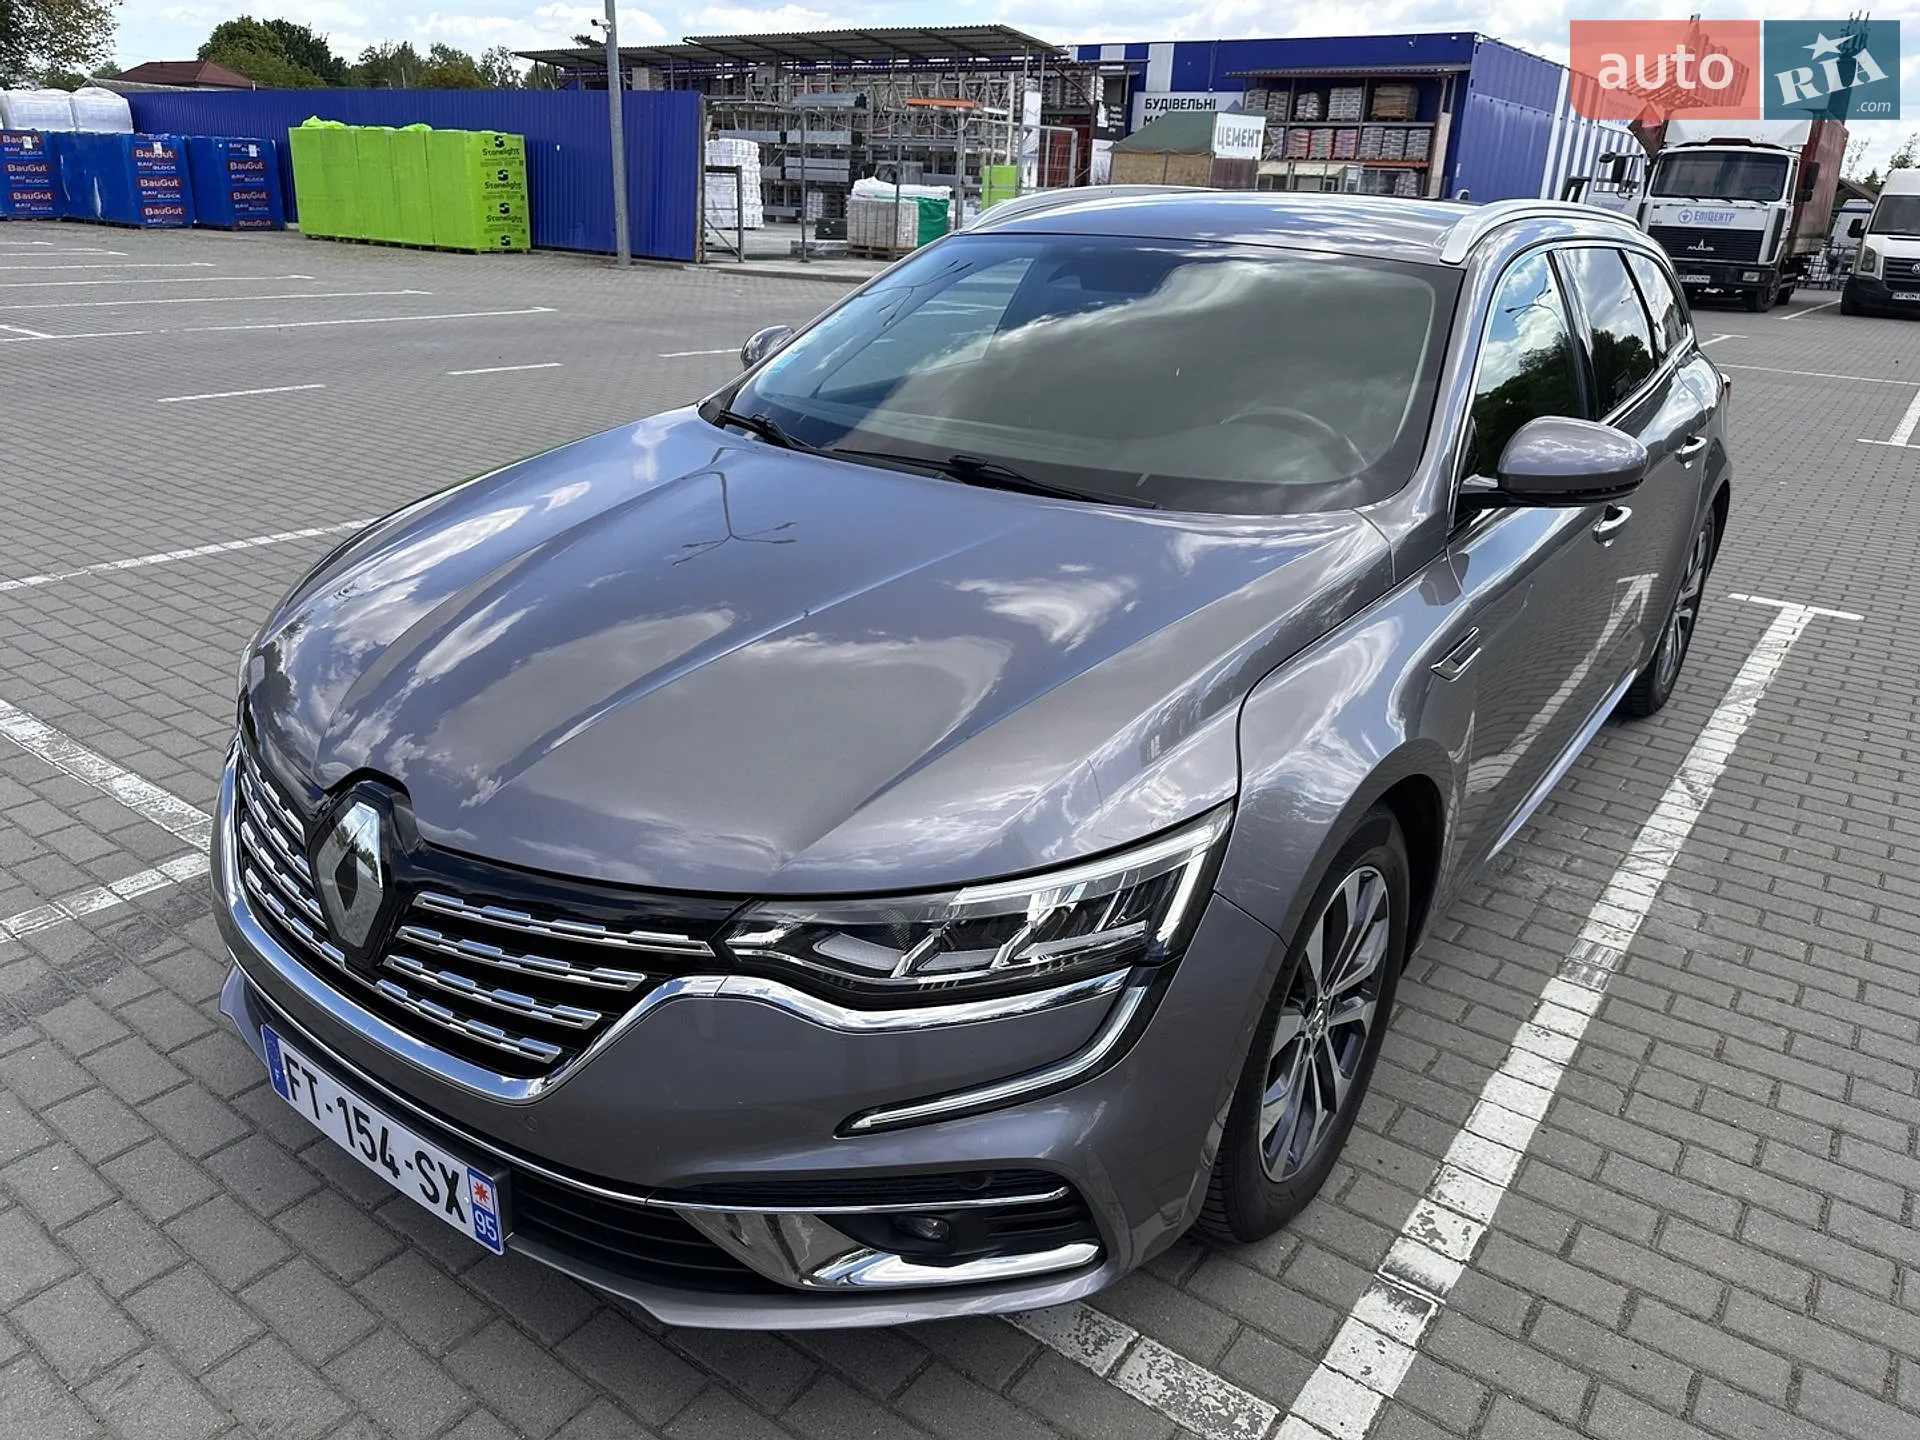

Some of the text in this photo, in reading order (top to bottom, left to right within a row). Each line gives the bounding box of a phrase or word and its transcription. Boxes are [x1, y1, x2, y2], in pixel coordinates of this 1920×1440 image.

[1144, 98, 1217, 110] БУДІВЕЛЬНІ
[1217, 127, 1262, 149] ЦЕМЕНТ
[482, 147, 520, 156] Stonelight
[7, 164, 47, 172] BauGut
[229, 162, 264, 170] BauGut
[140, 179, 179, 187] BauGut
[484, 181, 521, 190] Stonelight
[13, 191, 53, 200] BauGut
[233, 191, 267, 200] BauGut
[144, 205, 183, 215] BauGut
[486, 214, 523, 223] Stonelight
[1694, 210, 1735, 223] ЕПІЦЕНТР
[283, 1052, 467, 1224] FT-154-SX
[474, 1209, 497, 1242] 95
